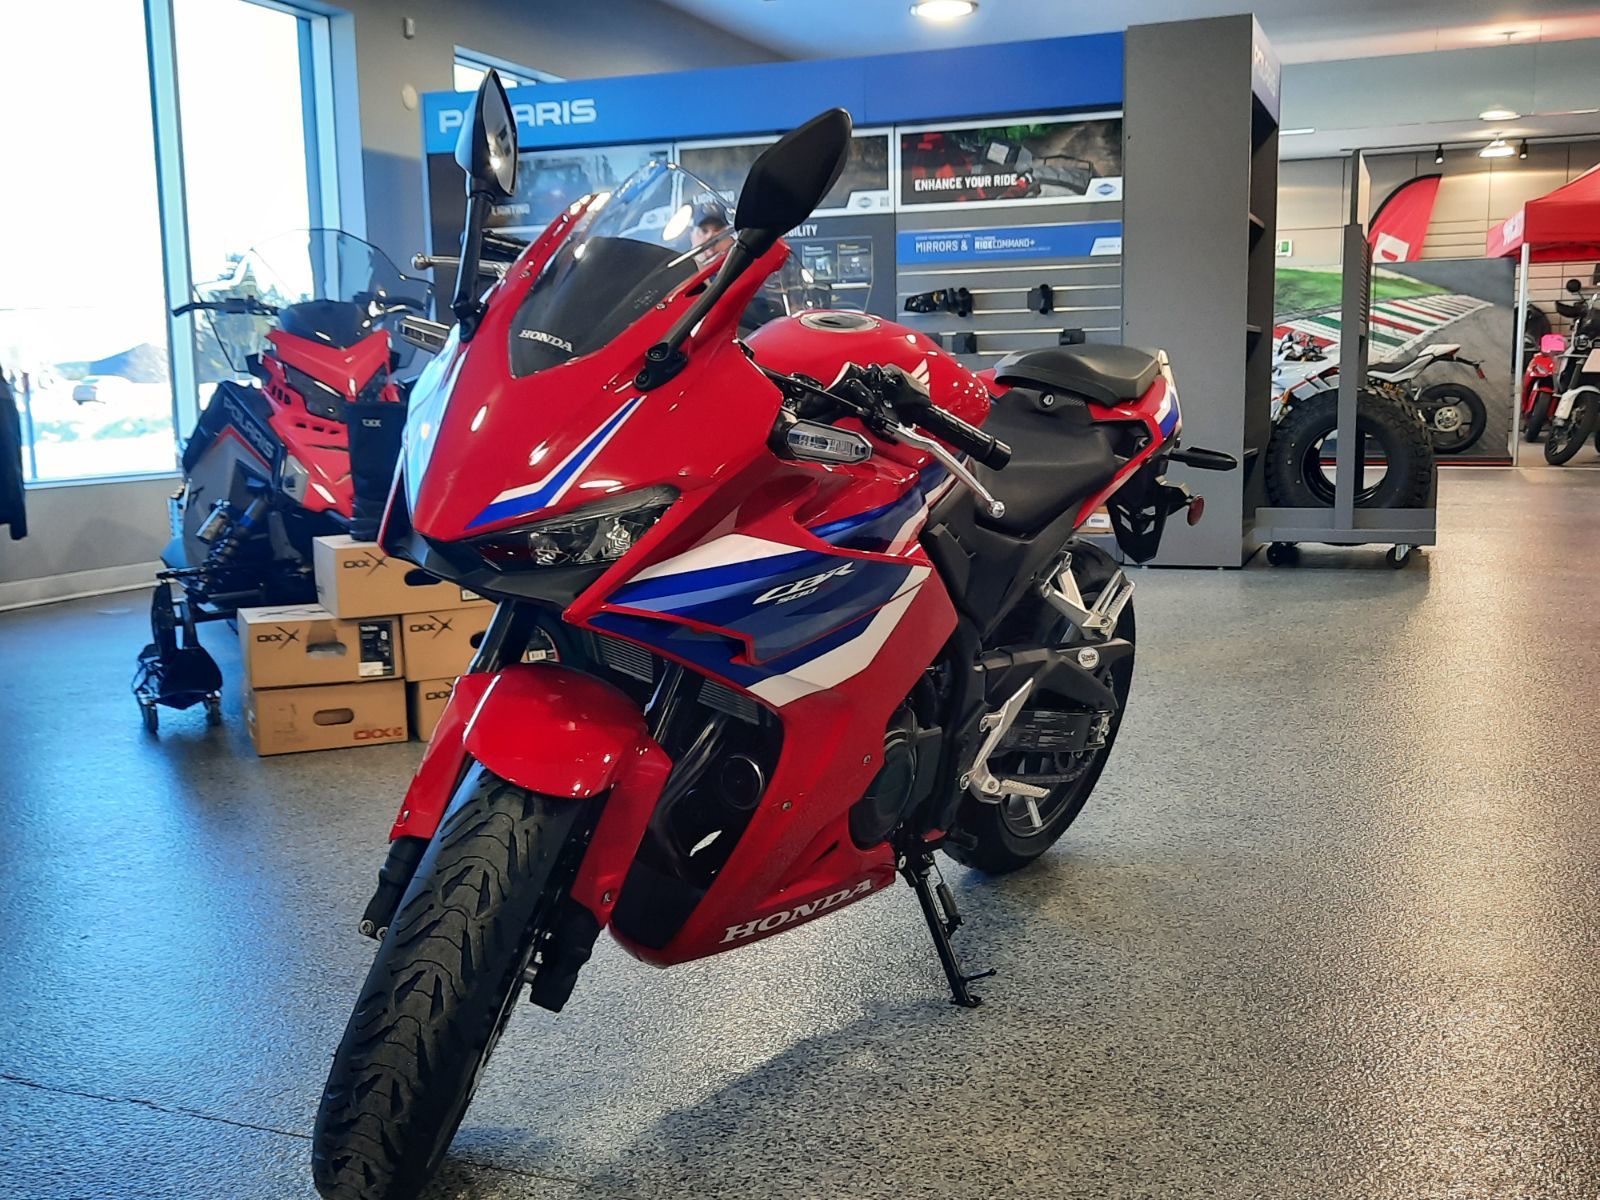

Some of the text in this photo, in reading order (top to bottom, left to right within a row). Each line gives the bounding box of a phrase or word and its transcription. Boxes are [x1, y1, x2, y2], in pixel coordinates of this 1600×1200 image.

[438, 98, 597, 134] PARIS
[914, 173, 1018, 192] ENHANCE YOUR RIDE
[915, 240, 958, 254] MIRRORS
[960, 239, 968, 252] &
[518, 329, 573, 353] HONDA
[223, 395, 276, 459] POLARIS
[751, 561, 856, 605] CBR
[380, 630, 388, 640] 8
[718, 878, 873, 944] HONDA
